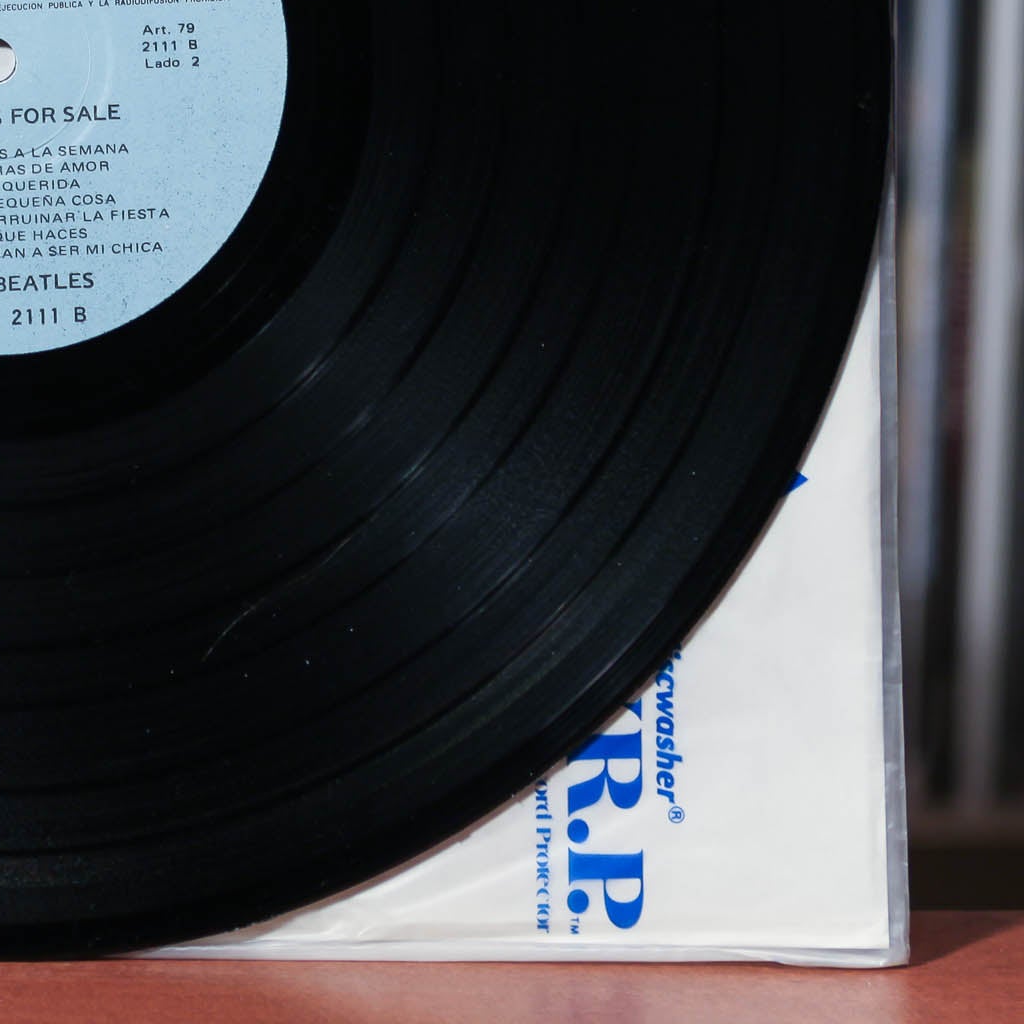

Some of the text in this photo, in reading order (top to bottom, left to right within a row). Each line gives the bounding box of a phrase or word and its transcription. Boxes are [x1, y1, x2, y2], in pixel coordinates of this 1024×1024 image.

[48, 0, 82, 9] PUBLICA
[98, 0, 109, 7] LA
[142, 22, 194, 35] Art. 79
[142, 39, 197, 52] 2111 B
[145, 55, 199, 68] Lado 2
[10, 107, 56, 124] FOR
[62, 103, 120, 122] SALE
[14, 147, 24, 158] A
[32, 146, 52, 157] LA
[58, 143, 128, 156] SEMANA
[31, 162, 53, 174] DE
[60, 160, 109, 173] AMOR
[2, 178, 80, 192] QUERIDA
[71, 193, 116, 206] COSA
[82, 210, 104, 222] LA
[110, 207, 170, 221] FIESTA
[32, 227, 87, 241] HACES
[31, 246, 42, 257] A
[48, 245, 79, 256] SER
[86, 244, 104, 255] MI
[111, 241, 162, 254] CHICA
[11, 307, 57, 325] 2111
[74, 306, 86, 324] B
[535, 779, 553, 933] ord Protector
